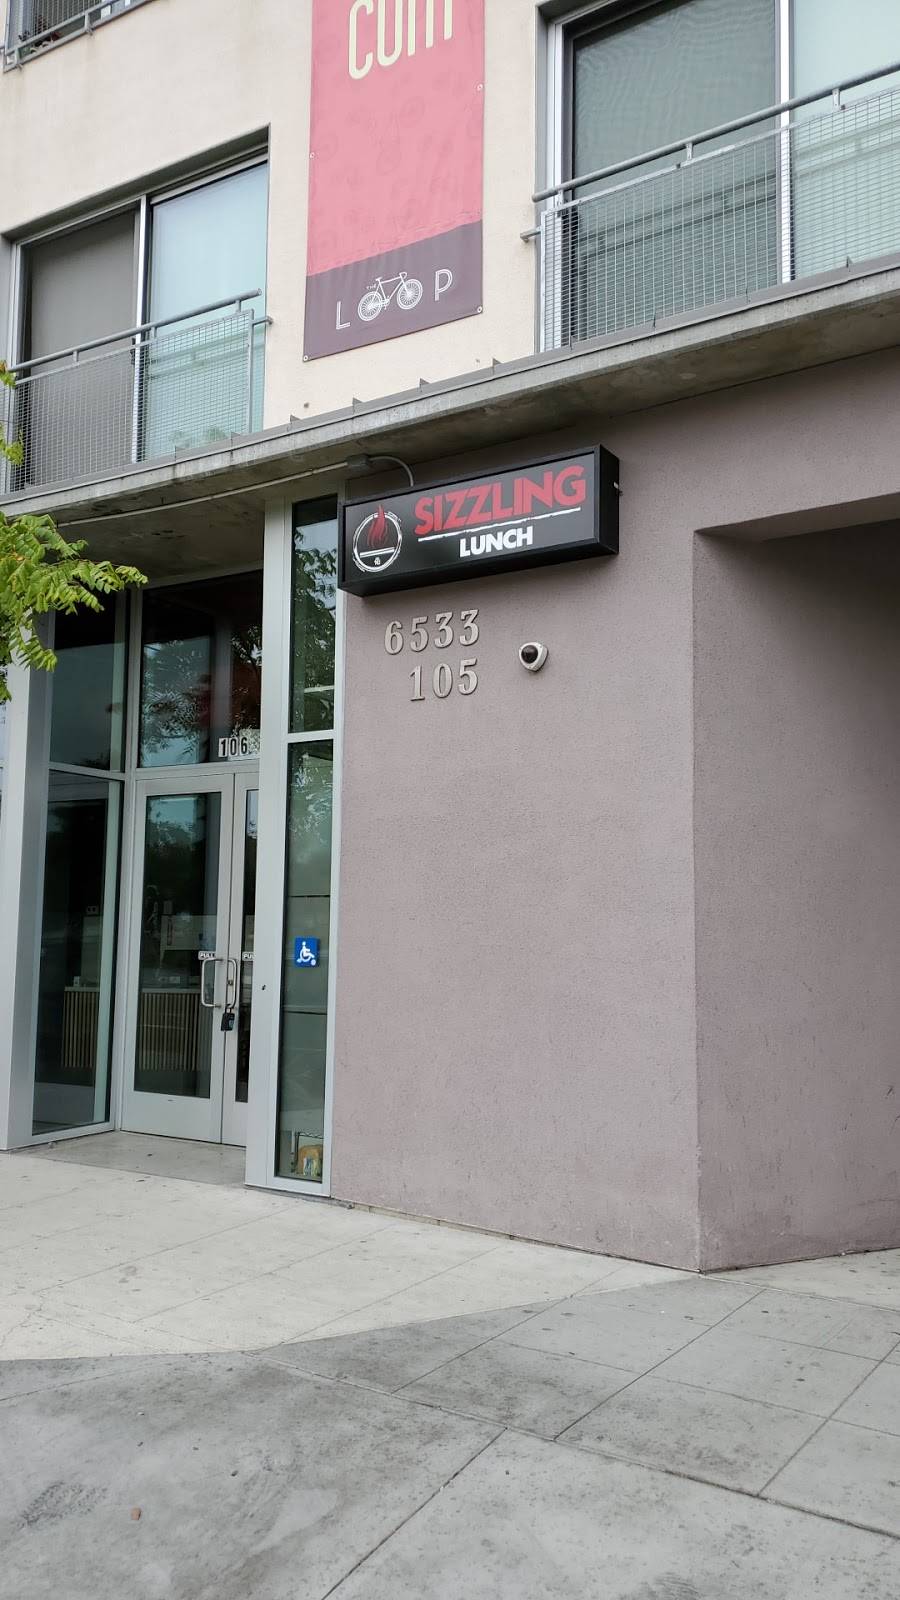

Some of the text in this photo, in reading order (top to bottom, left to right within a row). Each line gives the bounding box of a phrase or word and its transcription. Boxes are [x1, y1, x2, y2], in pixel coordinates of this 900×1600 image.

[414, 465, 586, 536] SIZZLING
[459, 526, 533, 558] LUNCH
[384, 608, 480, 655] 6533
[409, 658, 479, 701] 105
[220, 736, 249, 757] 106
